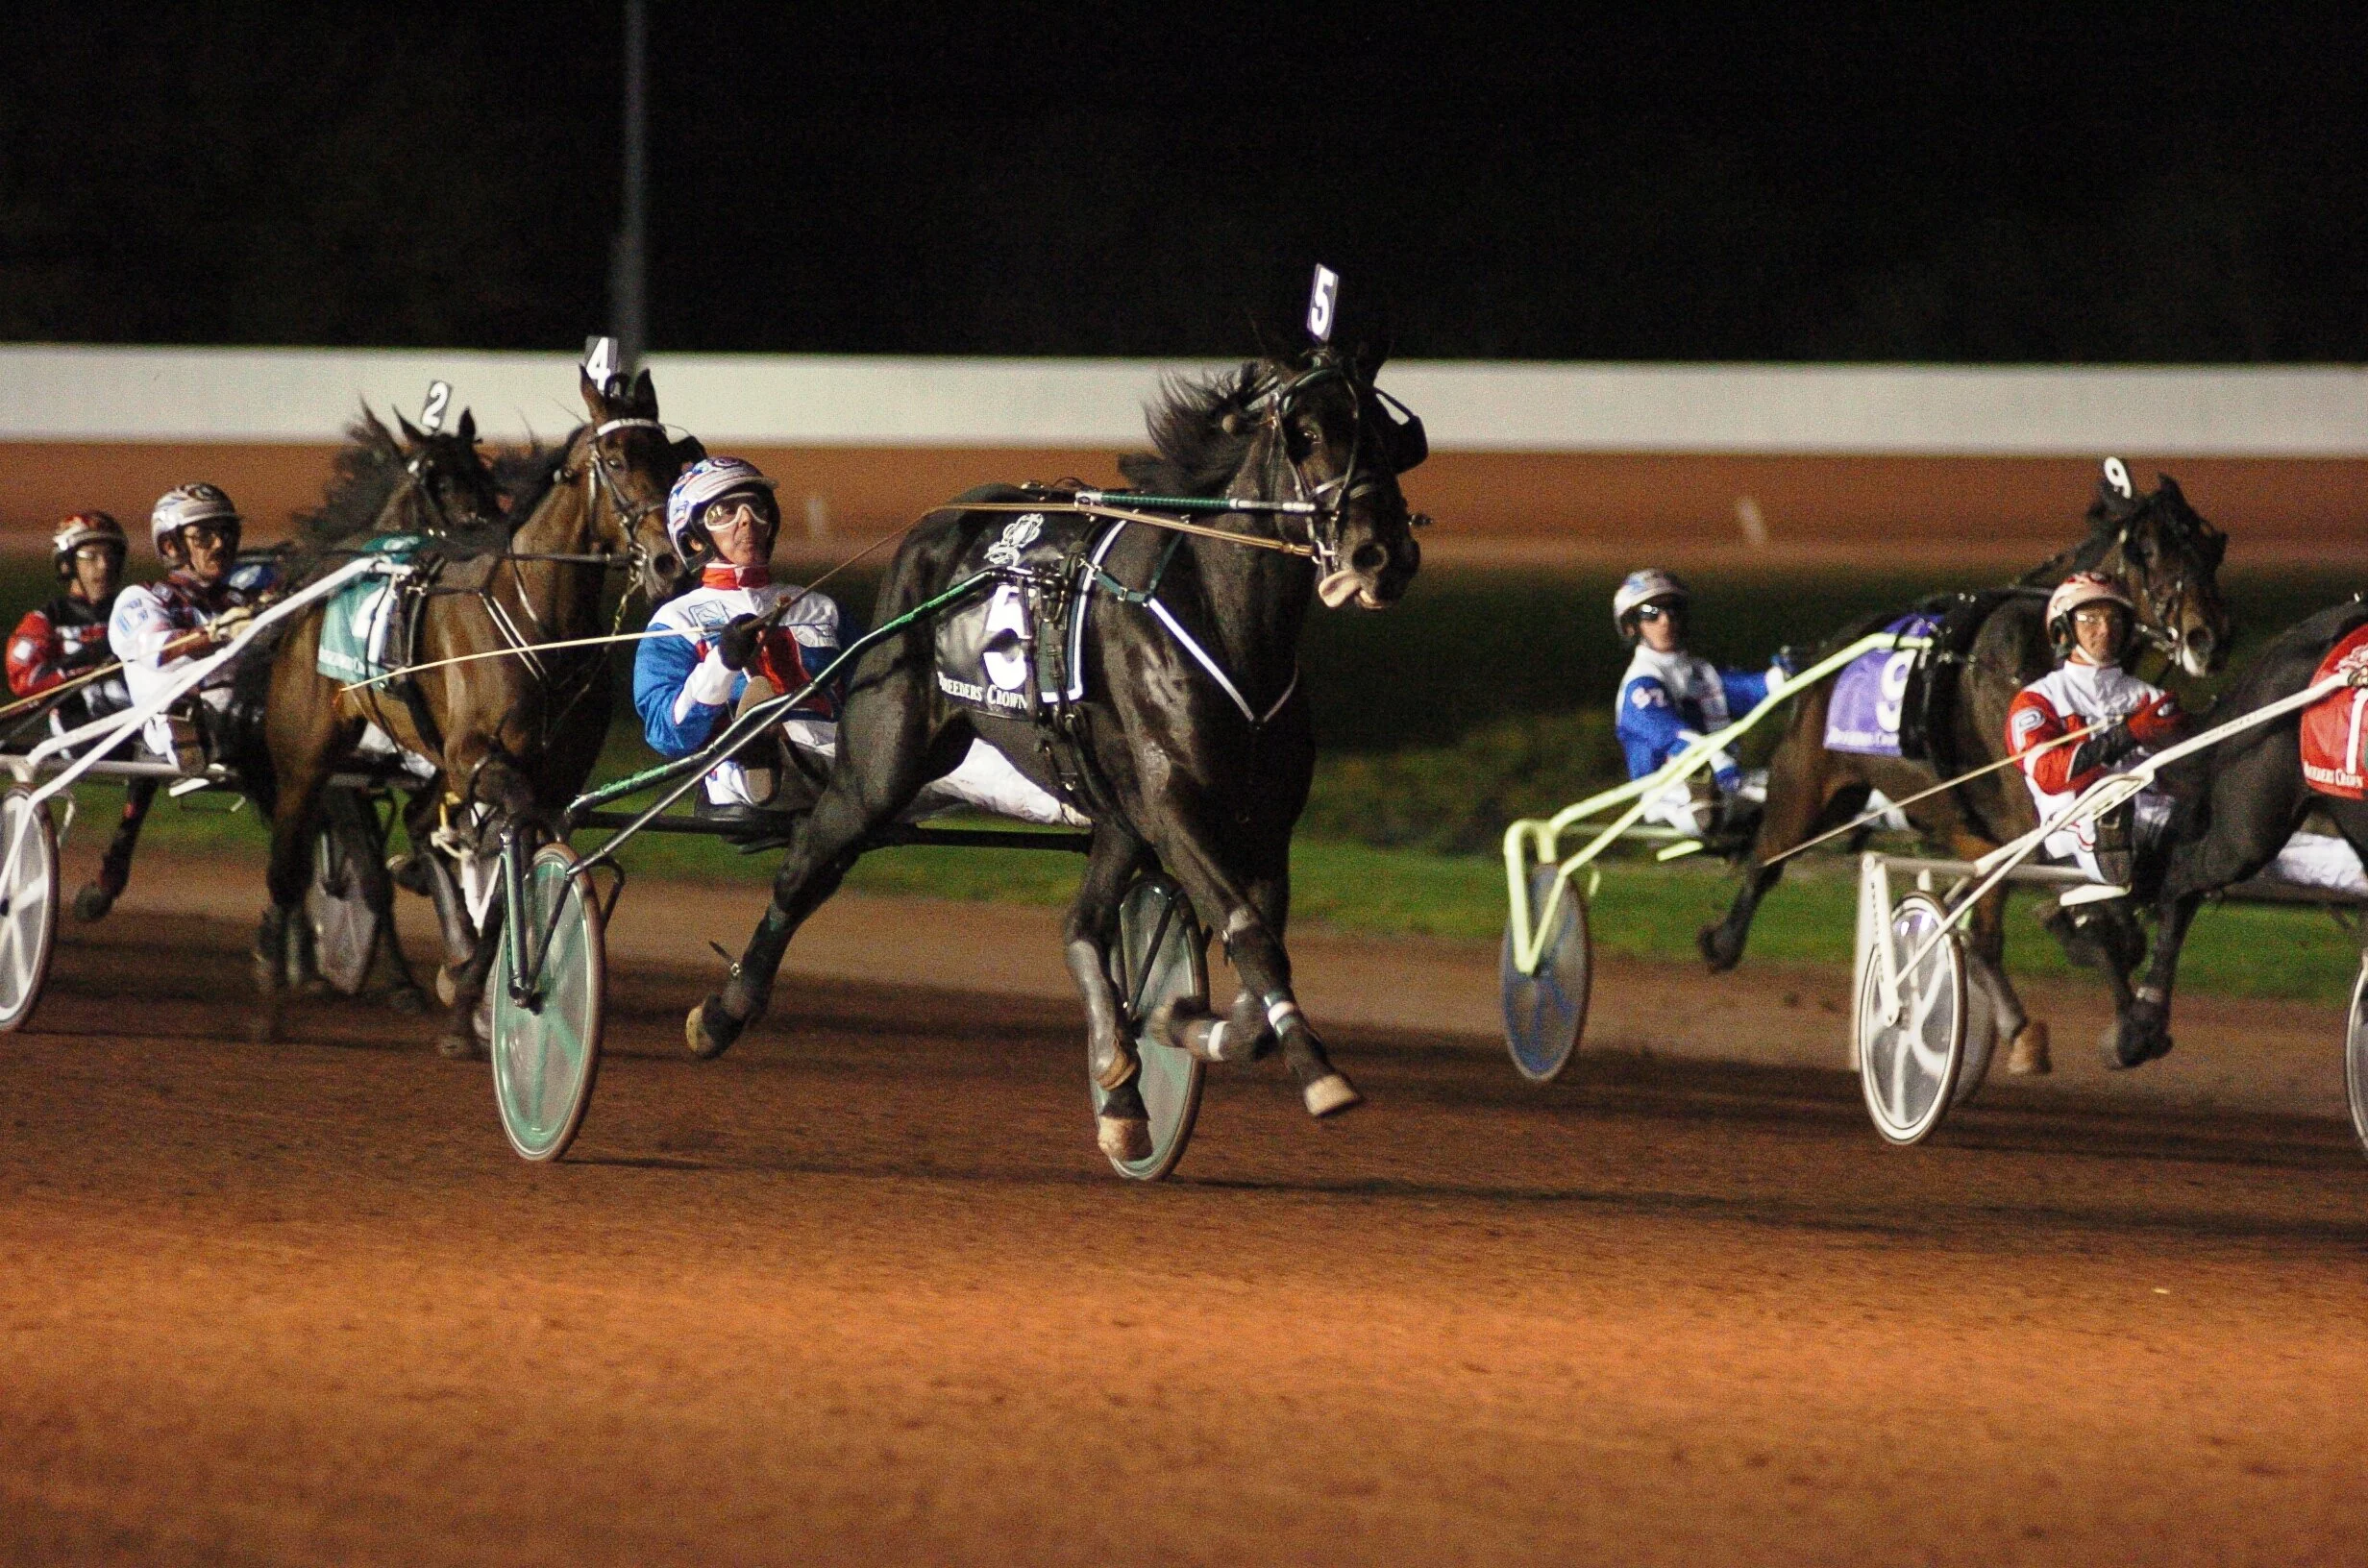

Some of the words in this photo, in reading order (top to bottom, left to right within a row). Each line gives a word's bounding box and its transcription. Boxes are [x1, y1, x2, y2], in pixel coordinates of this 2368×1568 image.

[1311, 267, 1334, 335] 5
[586, 336, 611, 391] 4
[422, 381, 448, 428] 2
[2104, 456, 2133, 499] 9
[983, 584, 1031, 690] 5
[1876, 649, 1917, 732] 9
